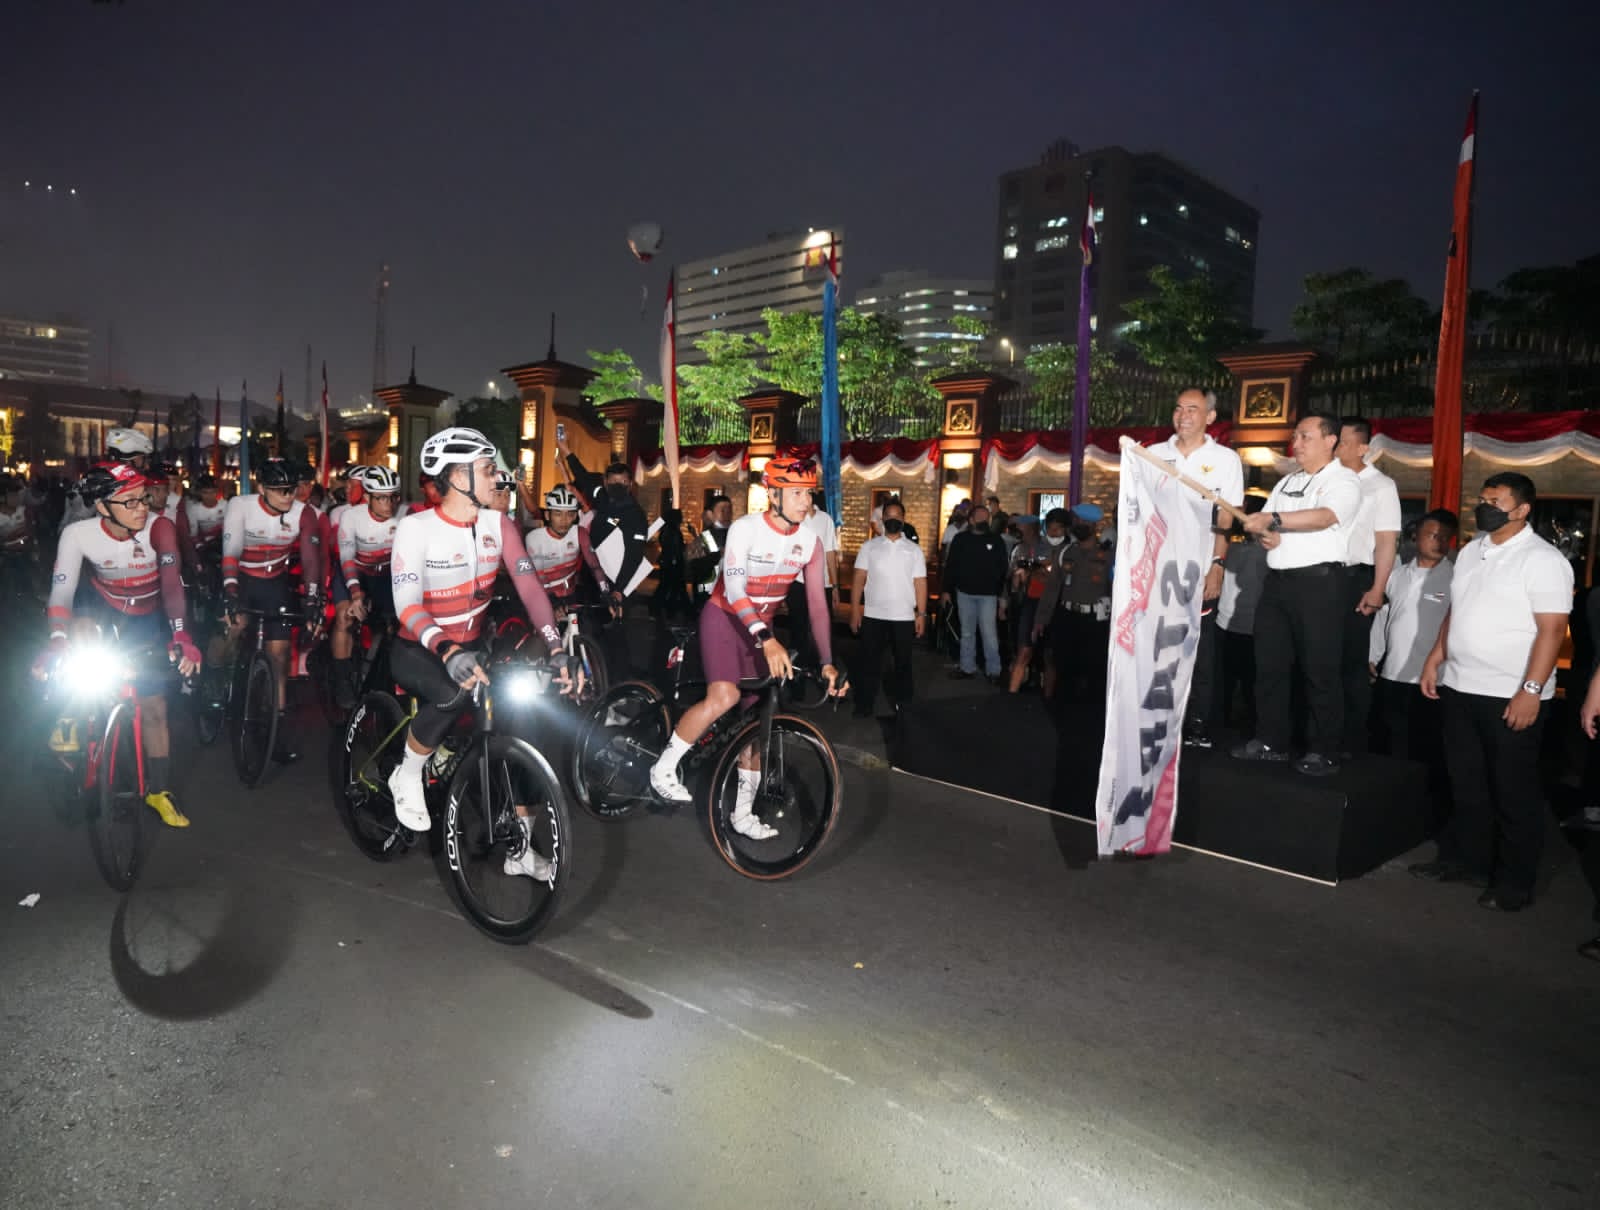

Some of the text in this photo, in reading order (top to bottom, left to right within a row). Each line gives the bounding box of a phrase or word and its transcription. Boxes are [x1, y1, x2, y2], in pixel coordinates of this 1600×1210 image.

[519, 561, 532, 571] 76
[727, 567, 746, 577] G20
[447, 794, 459, 871] roval
[547, 800, 560, 891] roval
